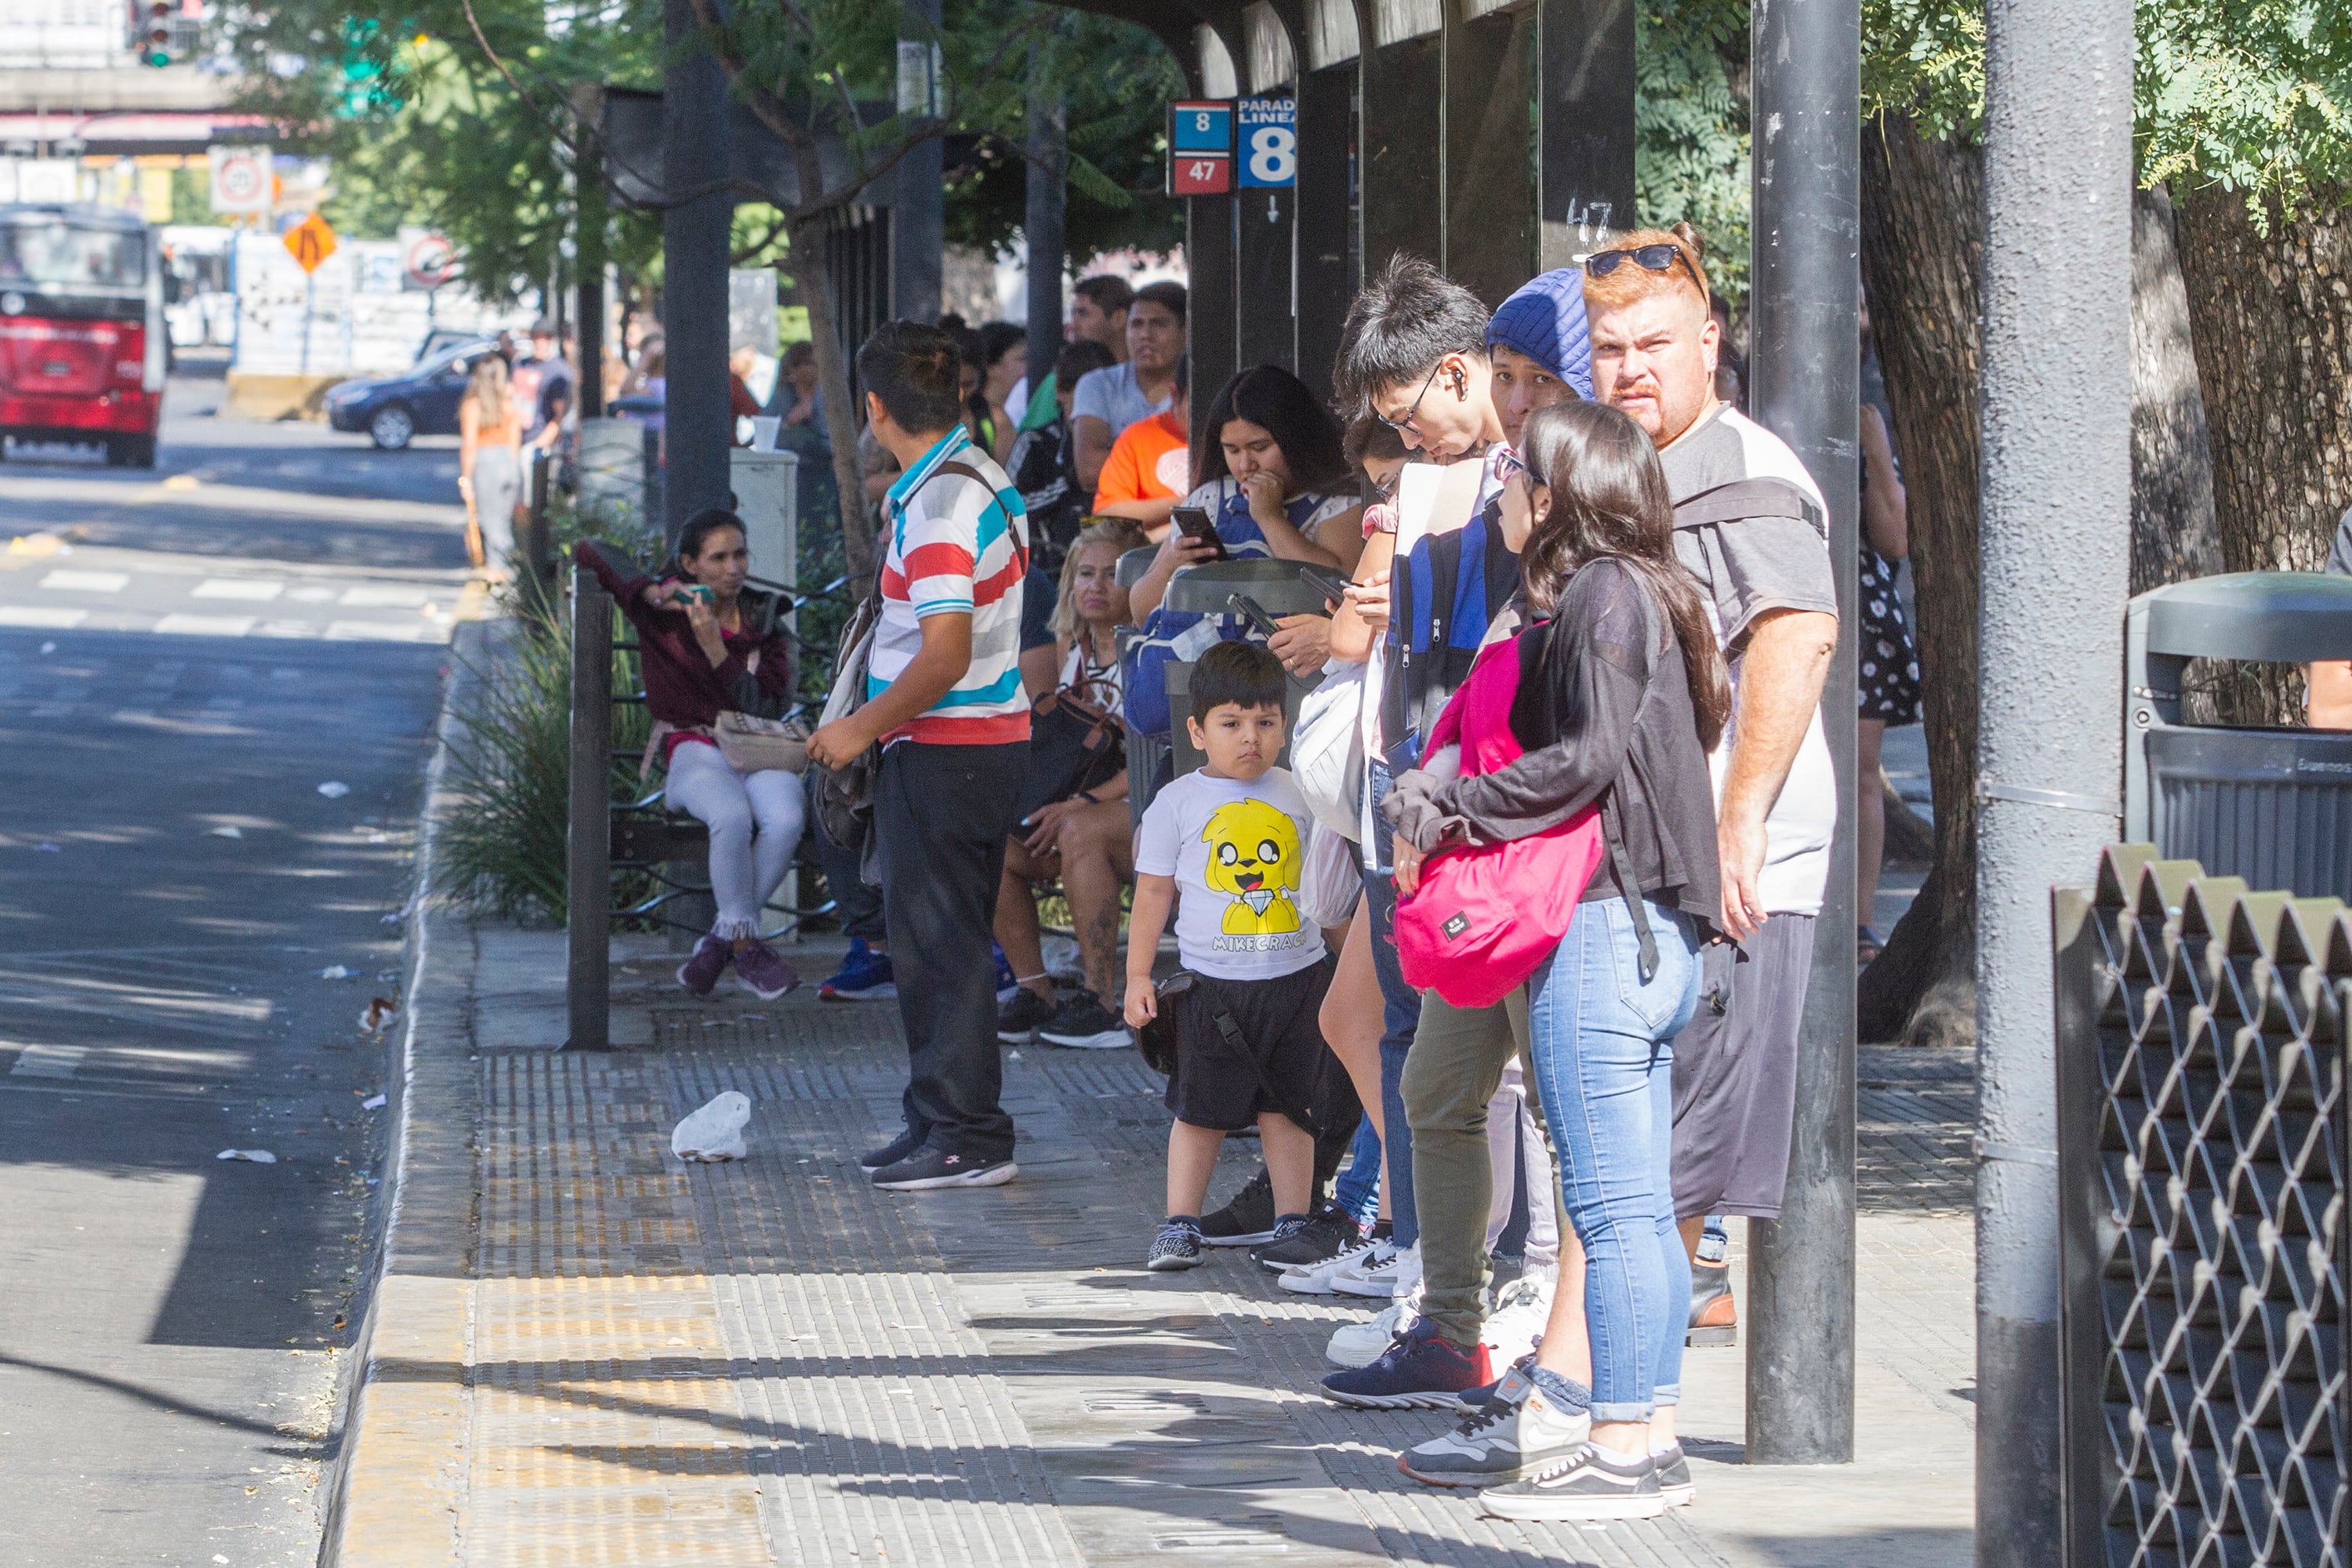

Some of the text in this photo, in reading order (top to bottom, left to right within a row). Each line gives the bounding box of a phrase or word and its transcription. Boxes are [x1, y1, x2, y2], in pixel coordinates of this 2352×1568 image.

[1196, 112, 1210, 131] 8
[1250, 126, 1295, 182] 8
[1189, 162, 1215, 180] 47
